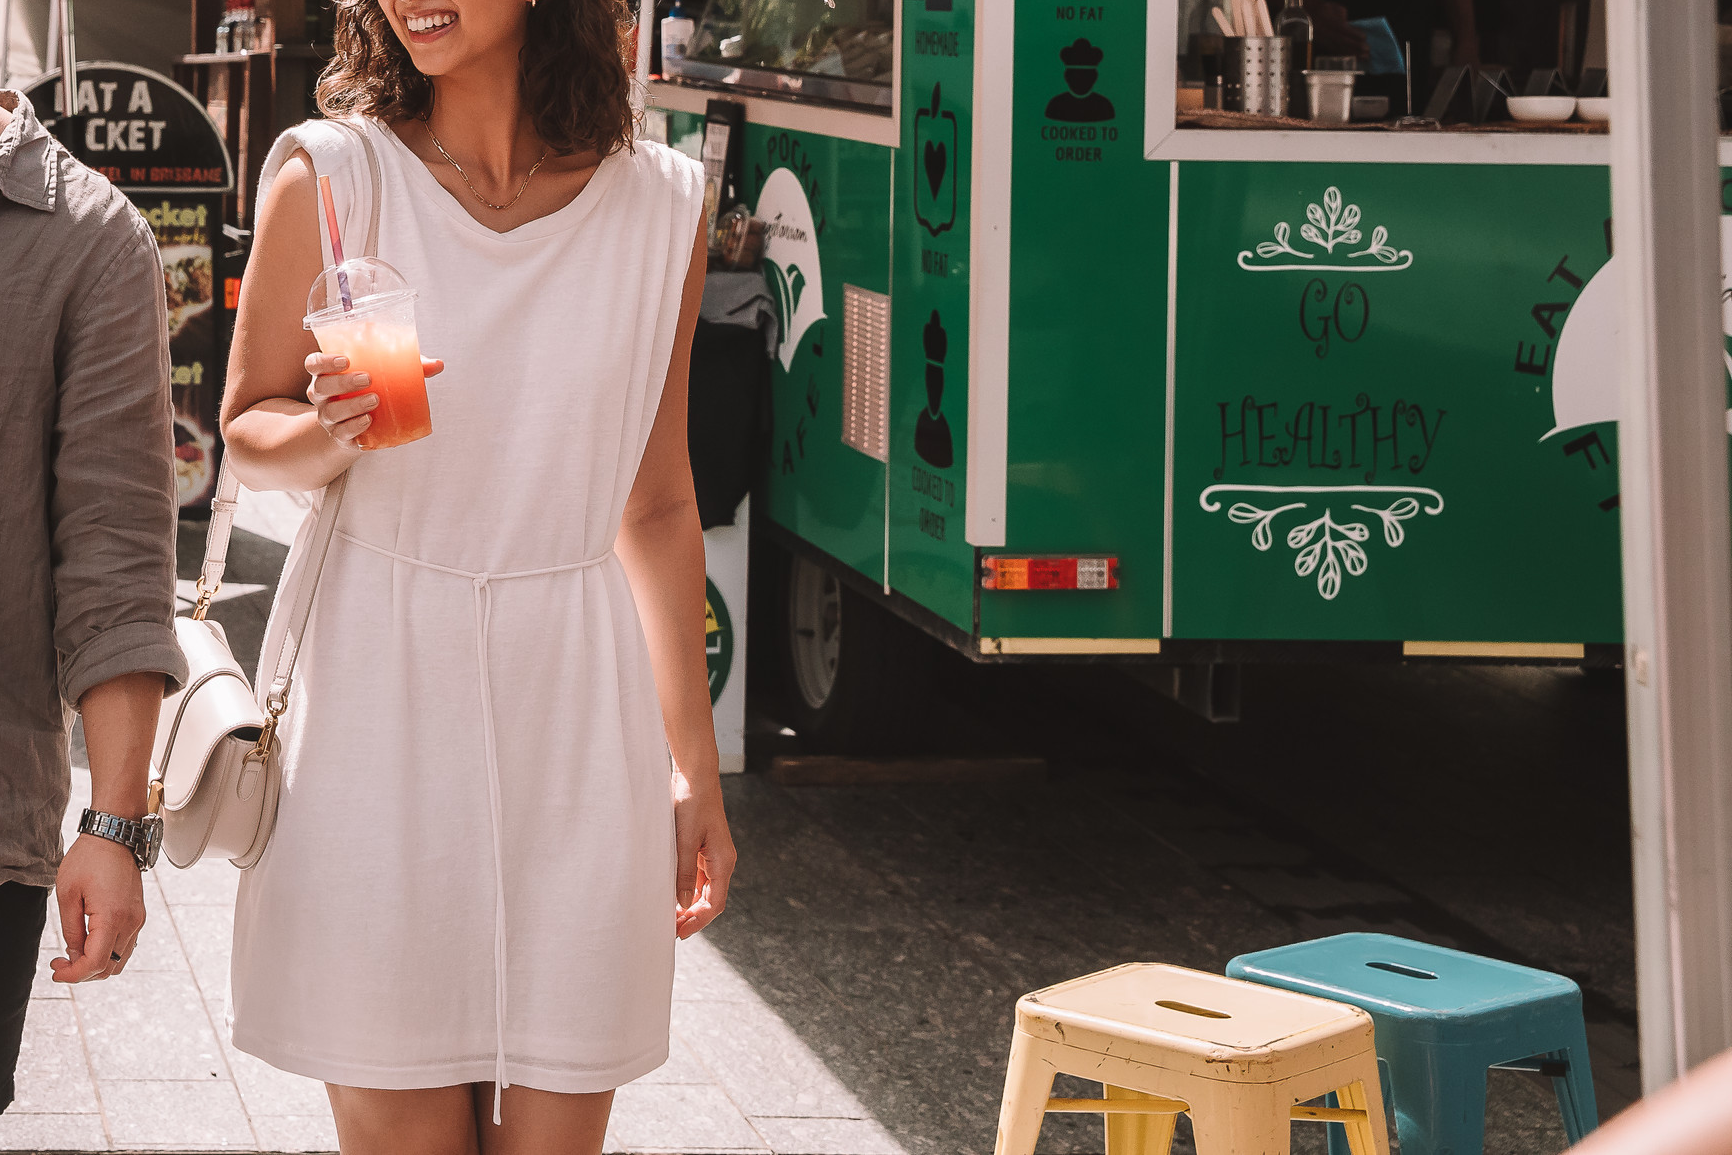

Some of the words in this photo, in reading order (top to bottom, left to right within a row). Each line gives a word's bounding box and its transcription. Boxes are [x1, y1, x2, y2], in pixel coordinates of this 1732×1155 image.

[1056, 6, 1075, 21] NO
[1079, 6, 1104, 21] FAT
[127, 79, 154, 115] A
[1040, 126, 1097, 142] COOKED
[1101, 127, 1119, 142] TO
[1055, 147, 1103, 162] ORDER
[150, 166, 223, 183] BRISBANE
[1299, 277, 1370, 360] GO
[1514, 254, 1585, 377] EAT
[1213, 392, 1449, 484] HEALTHY
